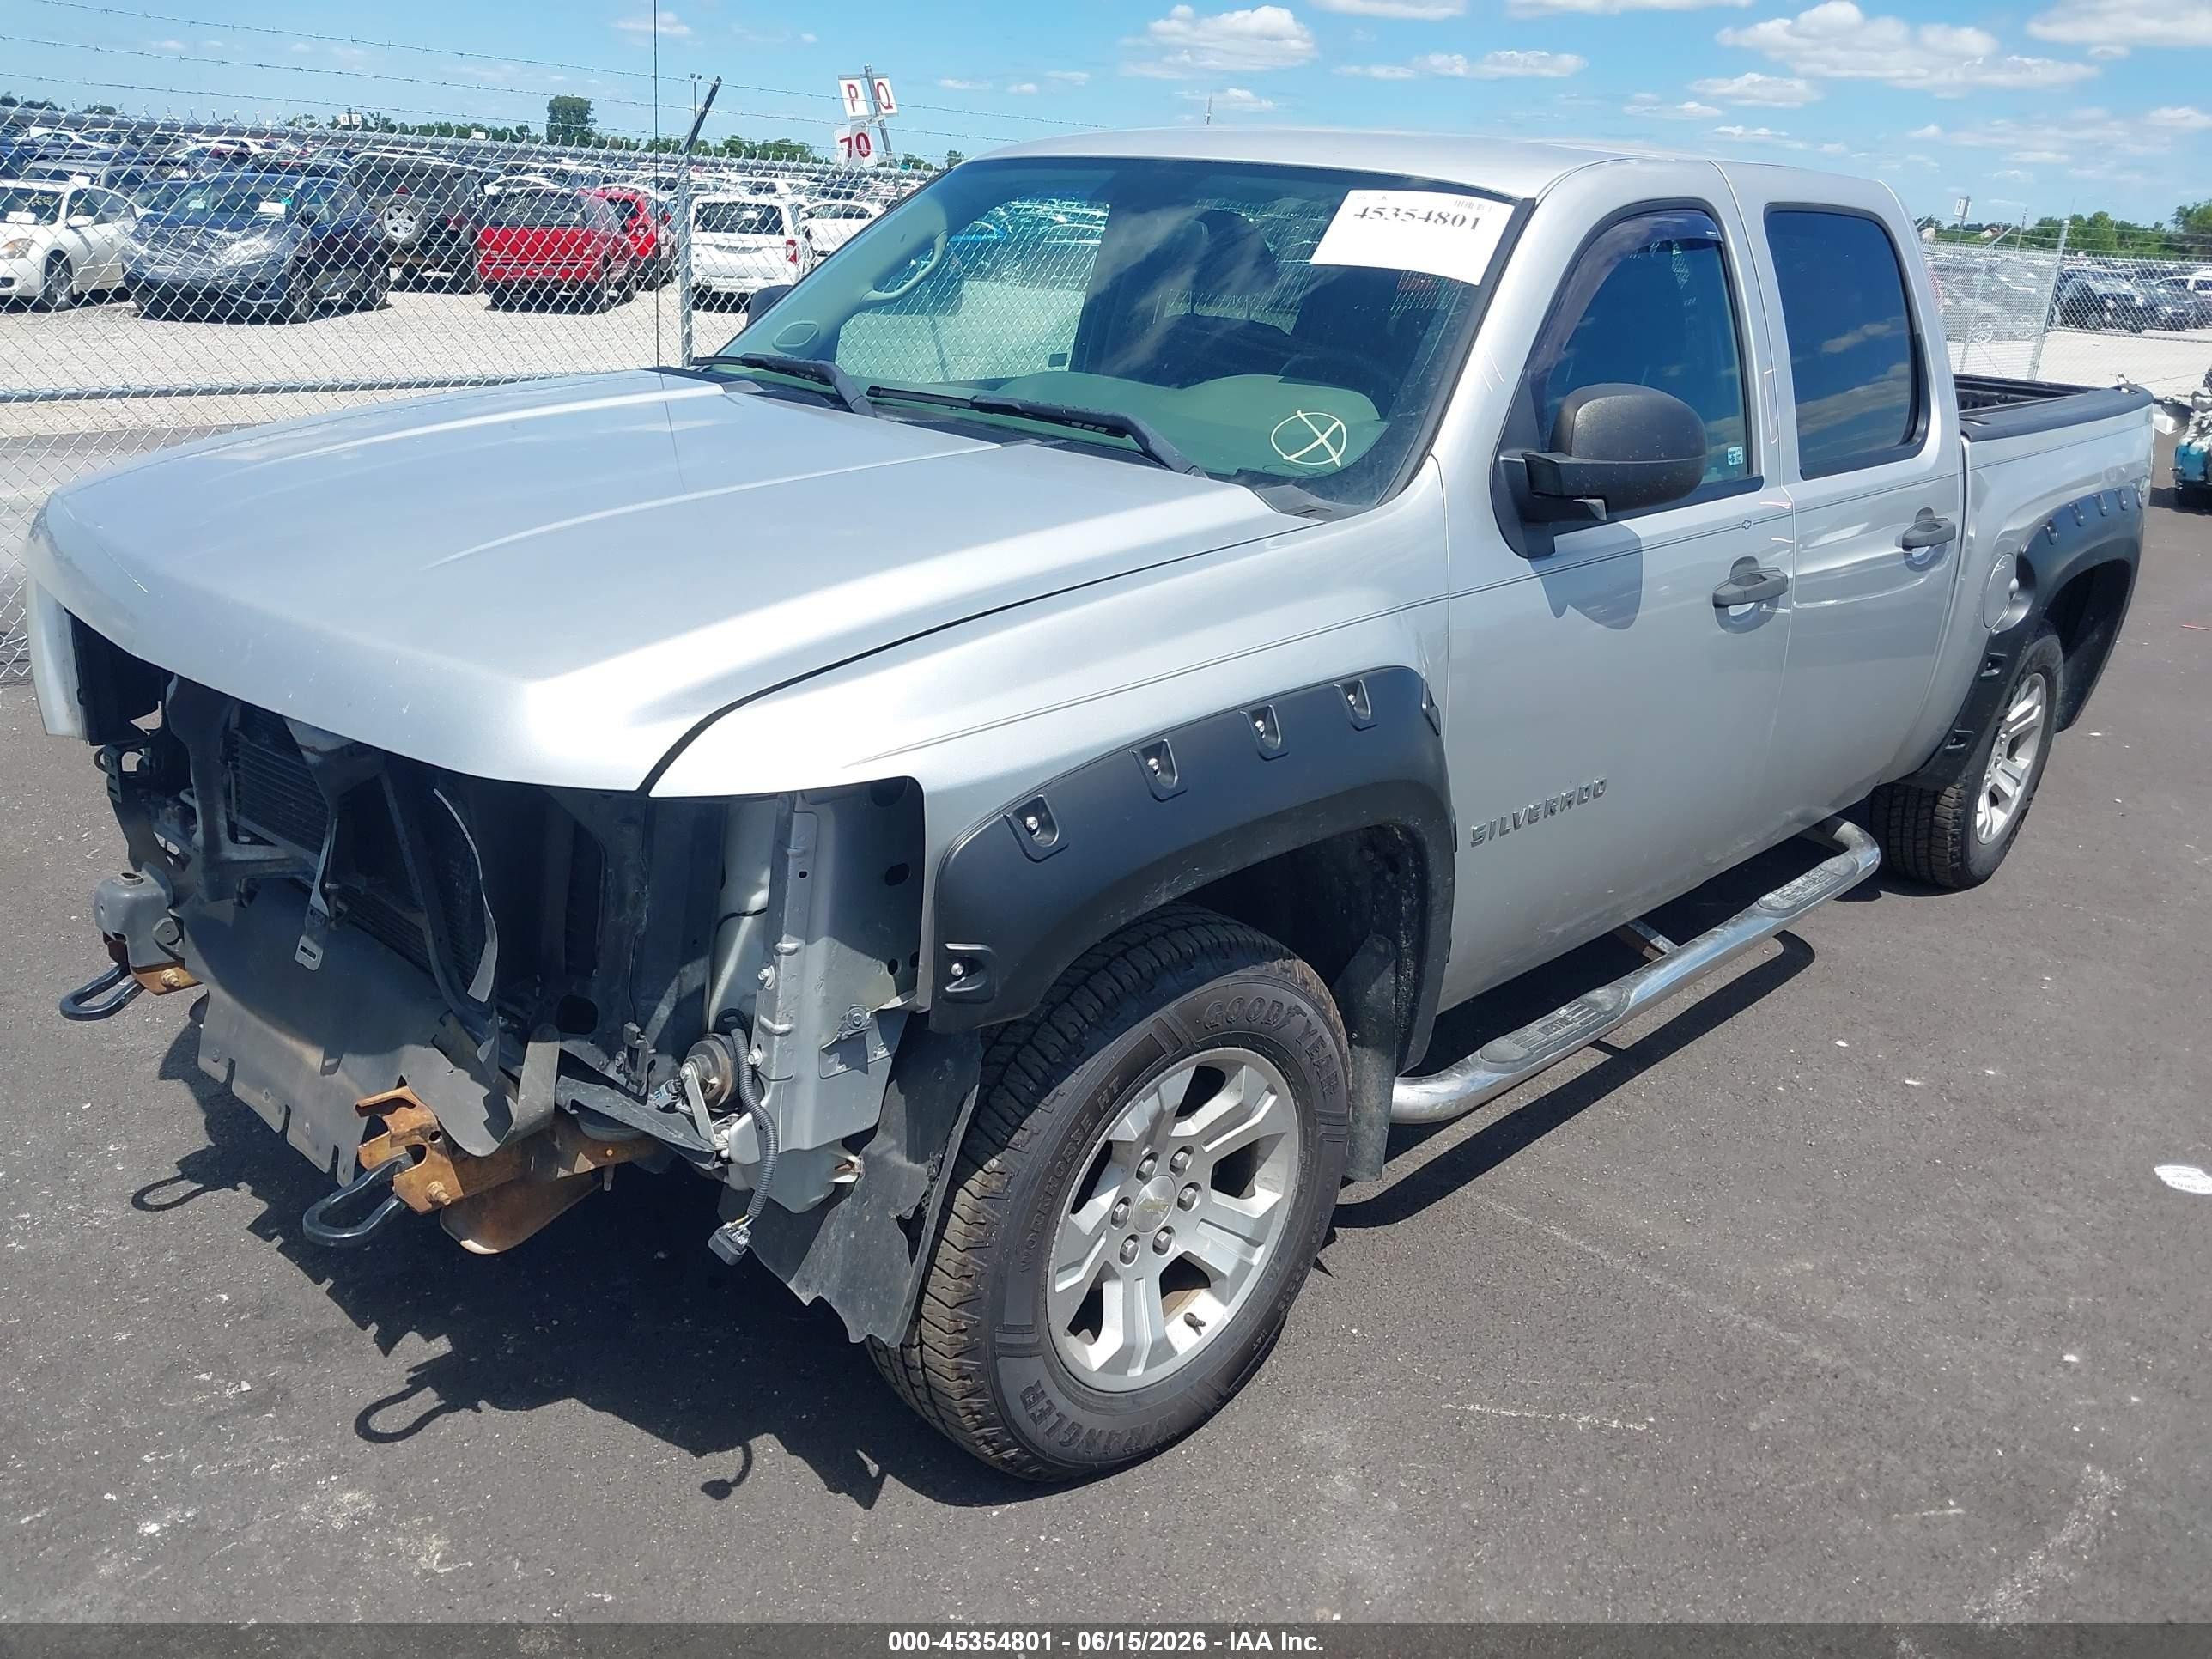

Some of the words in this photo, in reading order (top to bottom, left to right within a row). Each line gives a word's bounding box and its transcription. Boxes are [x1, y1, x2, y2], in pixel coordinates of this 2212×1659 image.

[846, 83, 859, 112] P
[876, 81, 894, 111] Q
[839, 131, 872, 160] 70
[1353, 206, 1480, 231] 45354801
[1469, 777, 1607, 848] SILVERADO
[1204, 996, 1340, 1103] GOODYEAR
[1019, 1113, 1093, 1273] WORKHORSE
[1097, 1076, 1121, 1111] HT
[1019, 1379, 1177, 1456] WRANGLER
